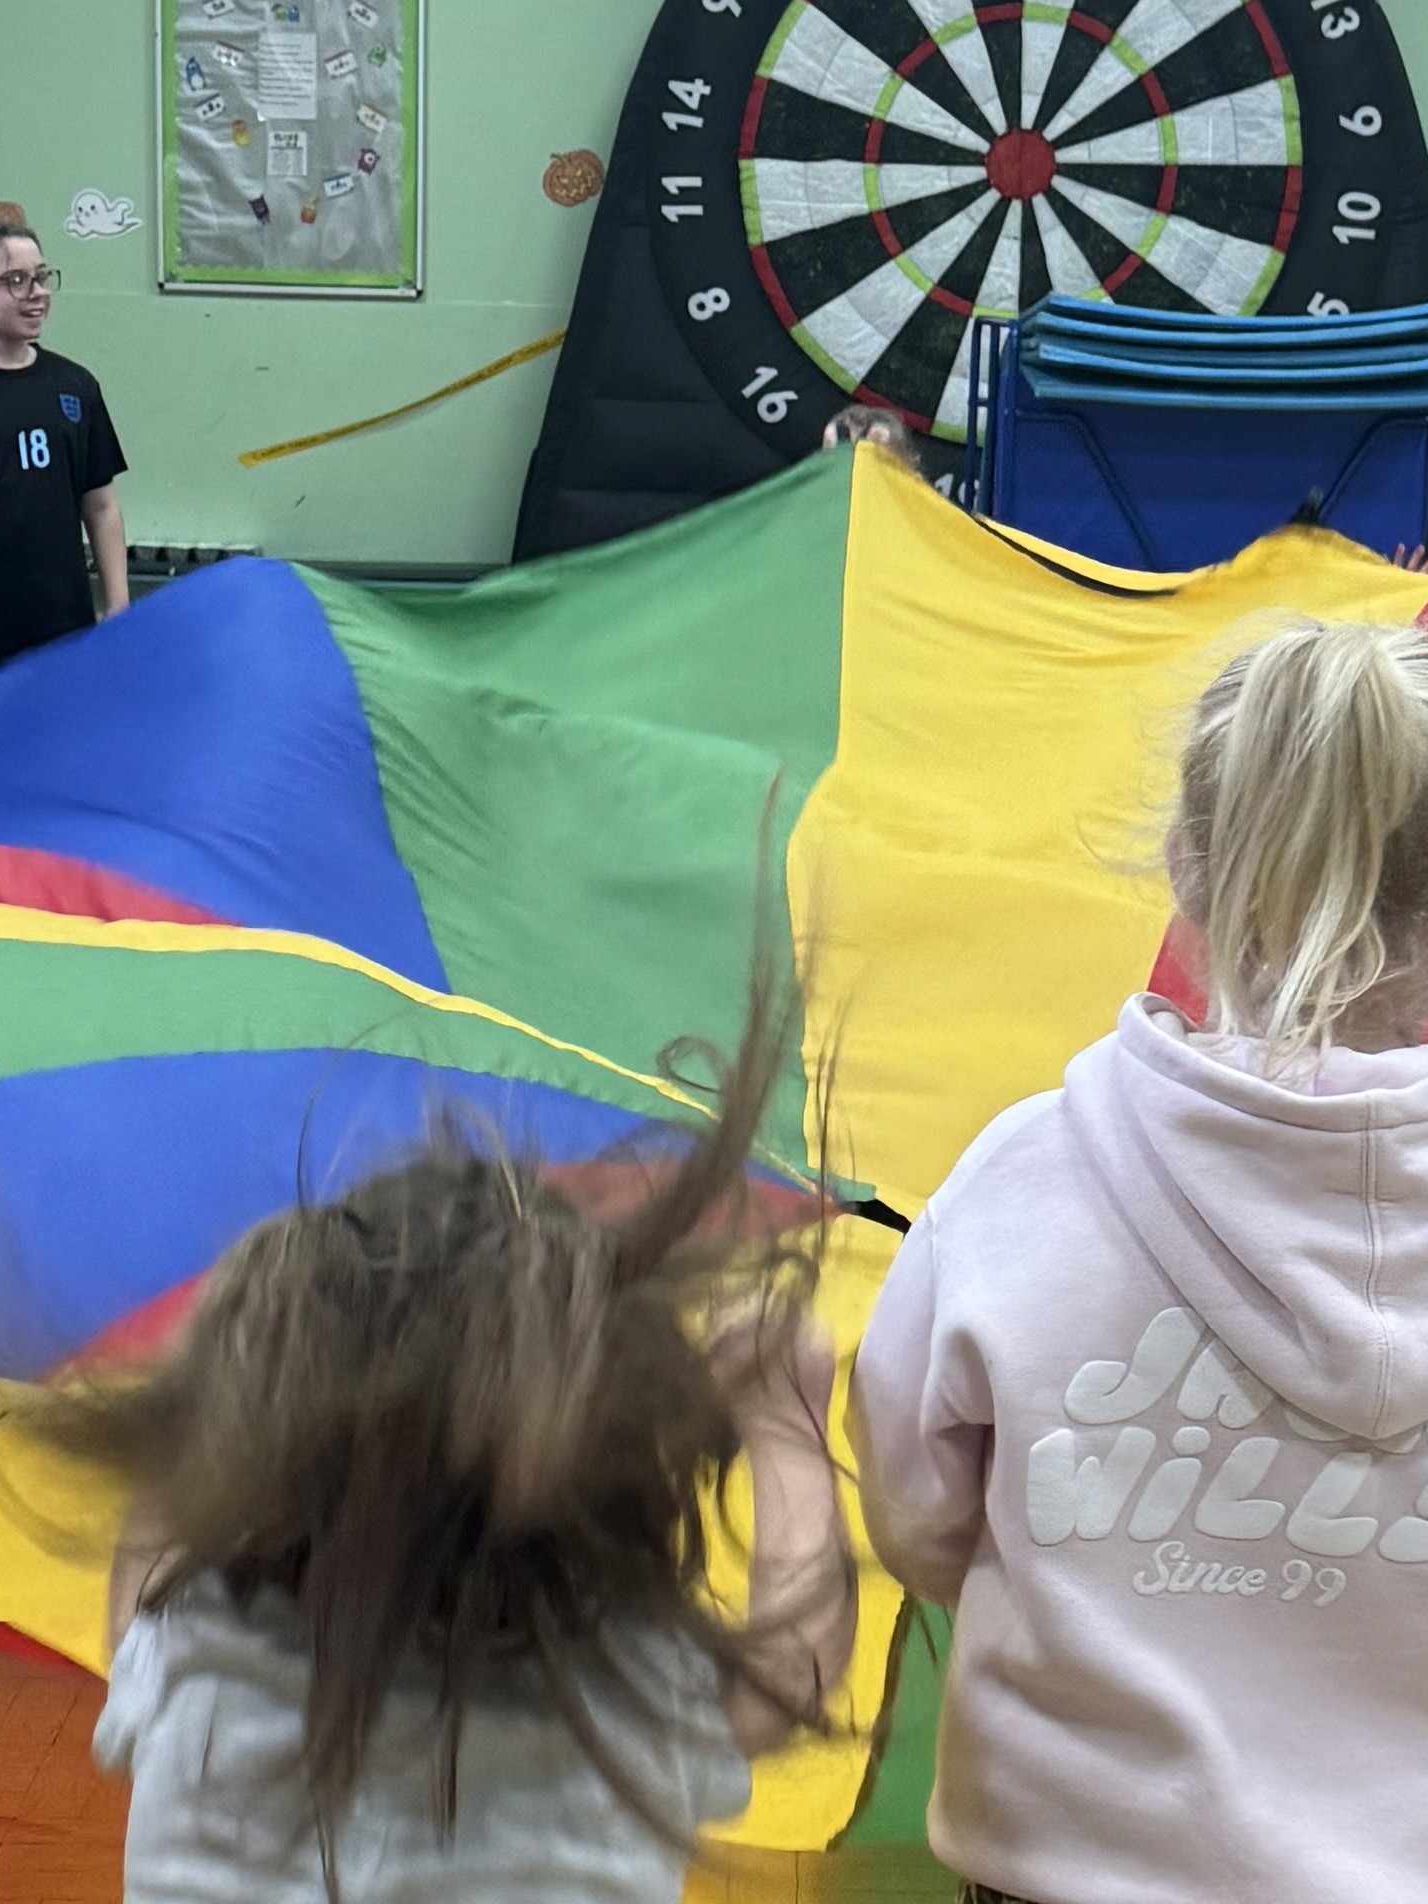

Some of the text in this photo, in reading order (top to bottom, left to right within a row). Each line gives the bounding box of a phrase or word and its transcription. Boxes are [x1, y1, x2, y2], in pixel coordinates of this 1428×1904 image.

[661, 78, 712, 131] 14
[1338, 105, 1382, 136] 6
[661, 176, 704, 223] 11
[1332, 191, 1381, 244] 10
[687, 287, 731, 321] 8
[741, 366, 799, 423] 16
[18, 428, 51, 470] 18
[1132, 1540, 1348, 1607] Since 99
